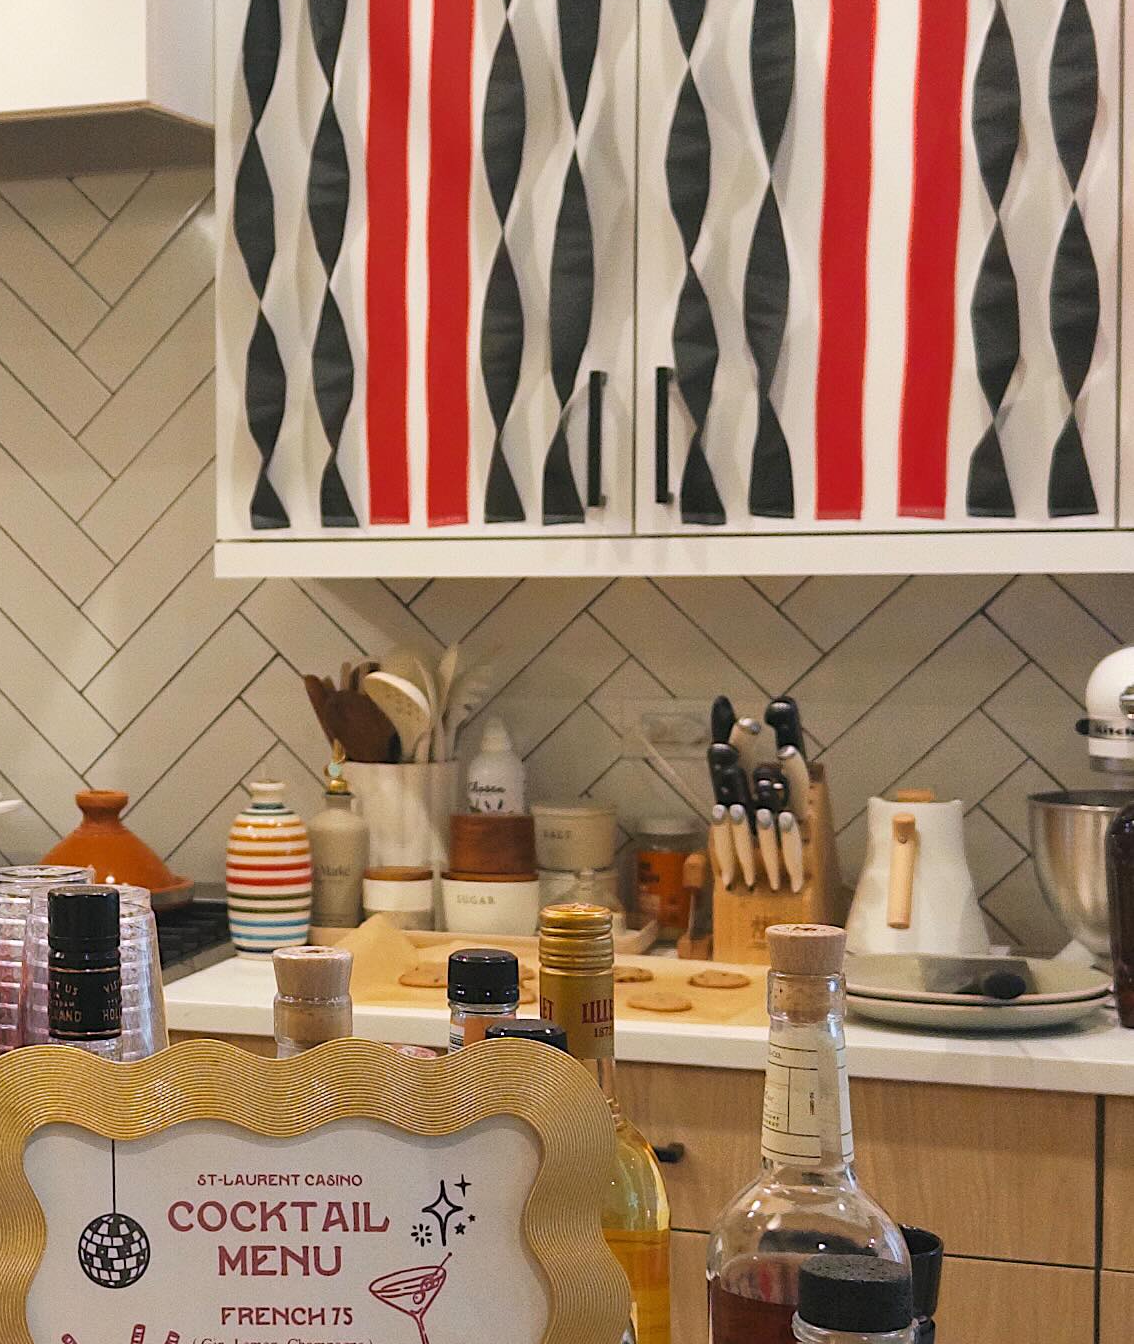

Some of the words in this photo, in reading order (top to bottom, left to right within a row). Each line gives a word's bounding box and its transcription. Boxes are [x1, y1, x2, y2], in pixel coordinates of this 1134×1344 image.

[457, 895, 495, 905] SUGAR
[198, 1174, 300, 1186] ST-LAURENT
[305, 1175, 362, 1186] CASINO
[168, 1201, 389, 1232] COCKTAIL
[218, 1245, 341, 1276] MENU
[222, 1307, 325, 1325] FRENCH
[332, 1307, 352, 1325] 75
